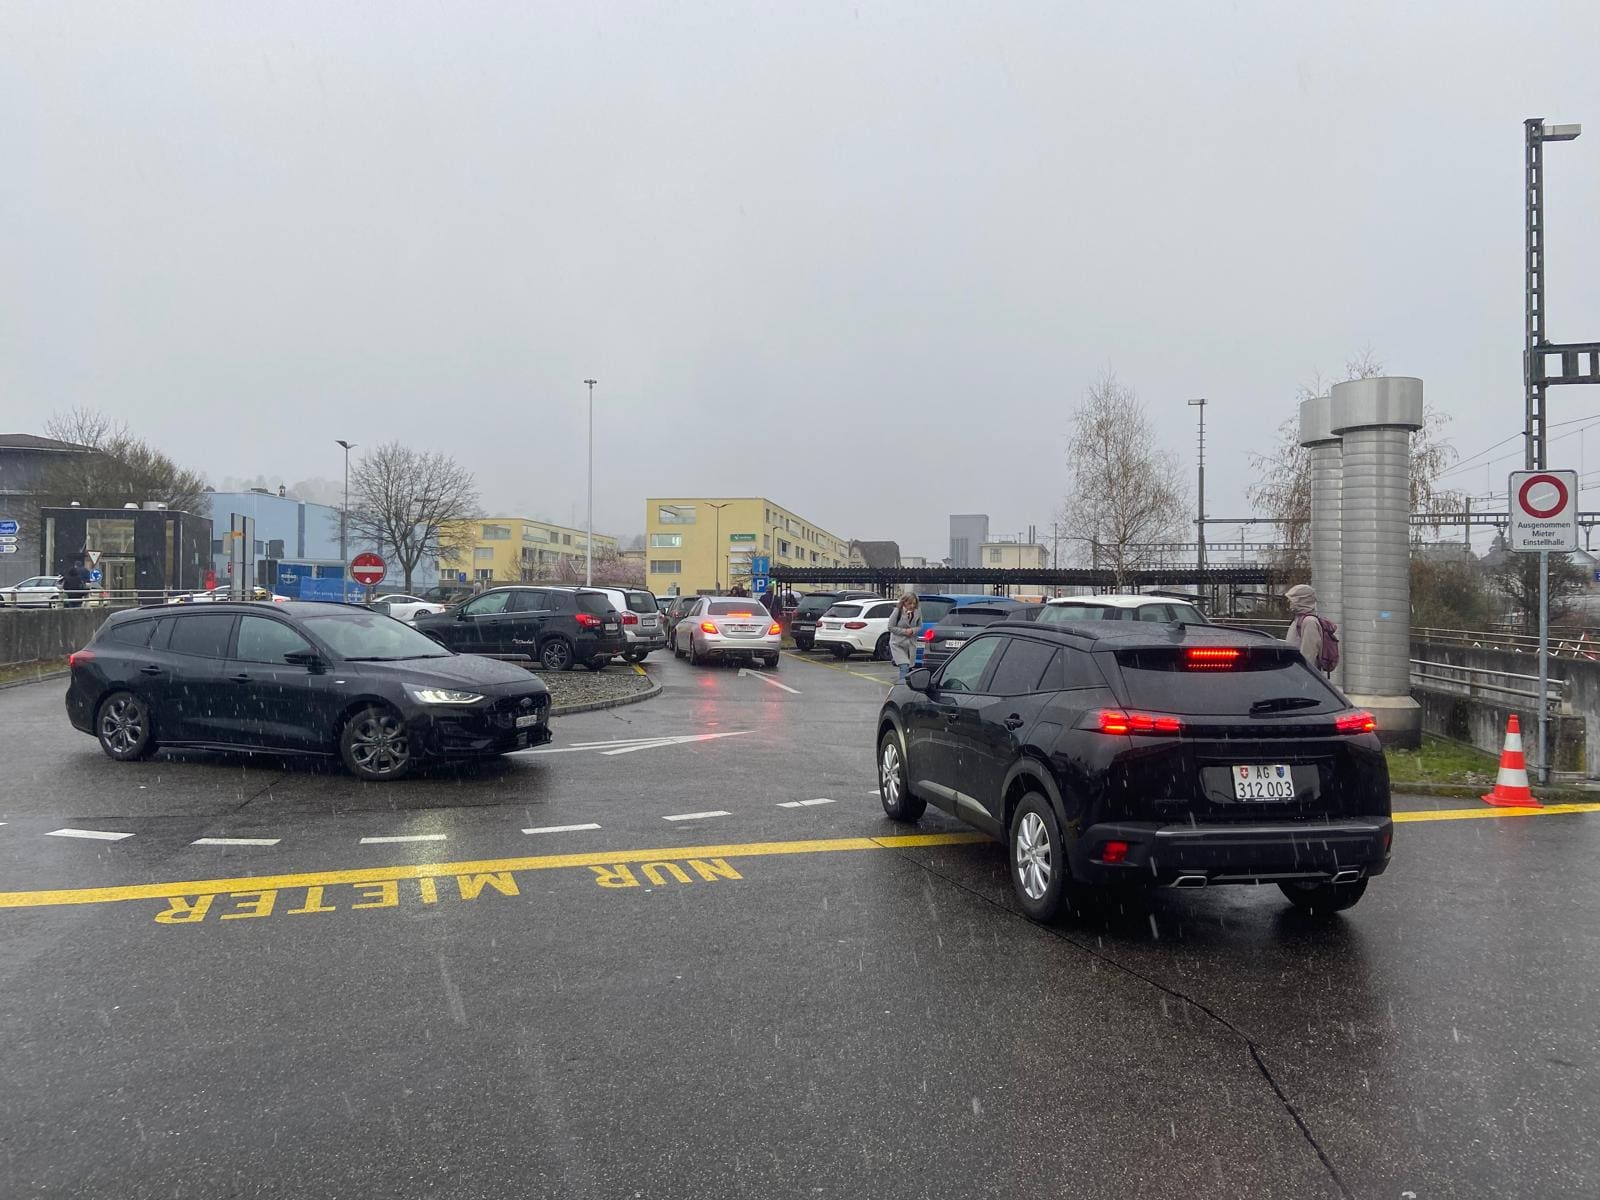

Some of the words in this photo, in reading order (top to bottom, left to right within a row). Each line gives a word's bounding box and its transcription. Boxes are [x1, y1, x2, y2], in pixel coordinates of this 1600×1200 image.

[757, 579, 765, 591] P
[1256, 766, 1270, 779] AG
[588, 858, 744, 888] NUR
[154, 872, 520, 924] MIETER
